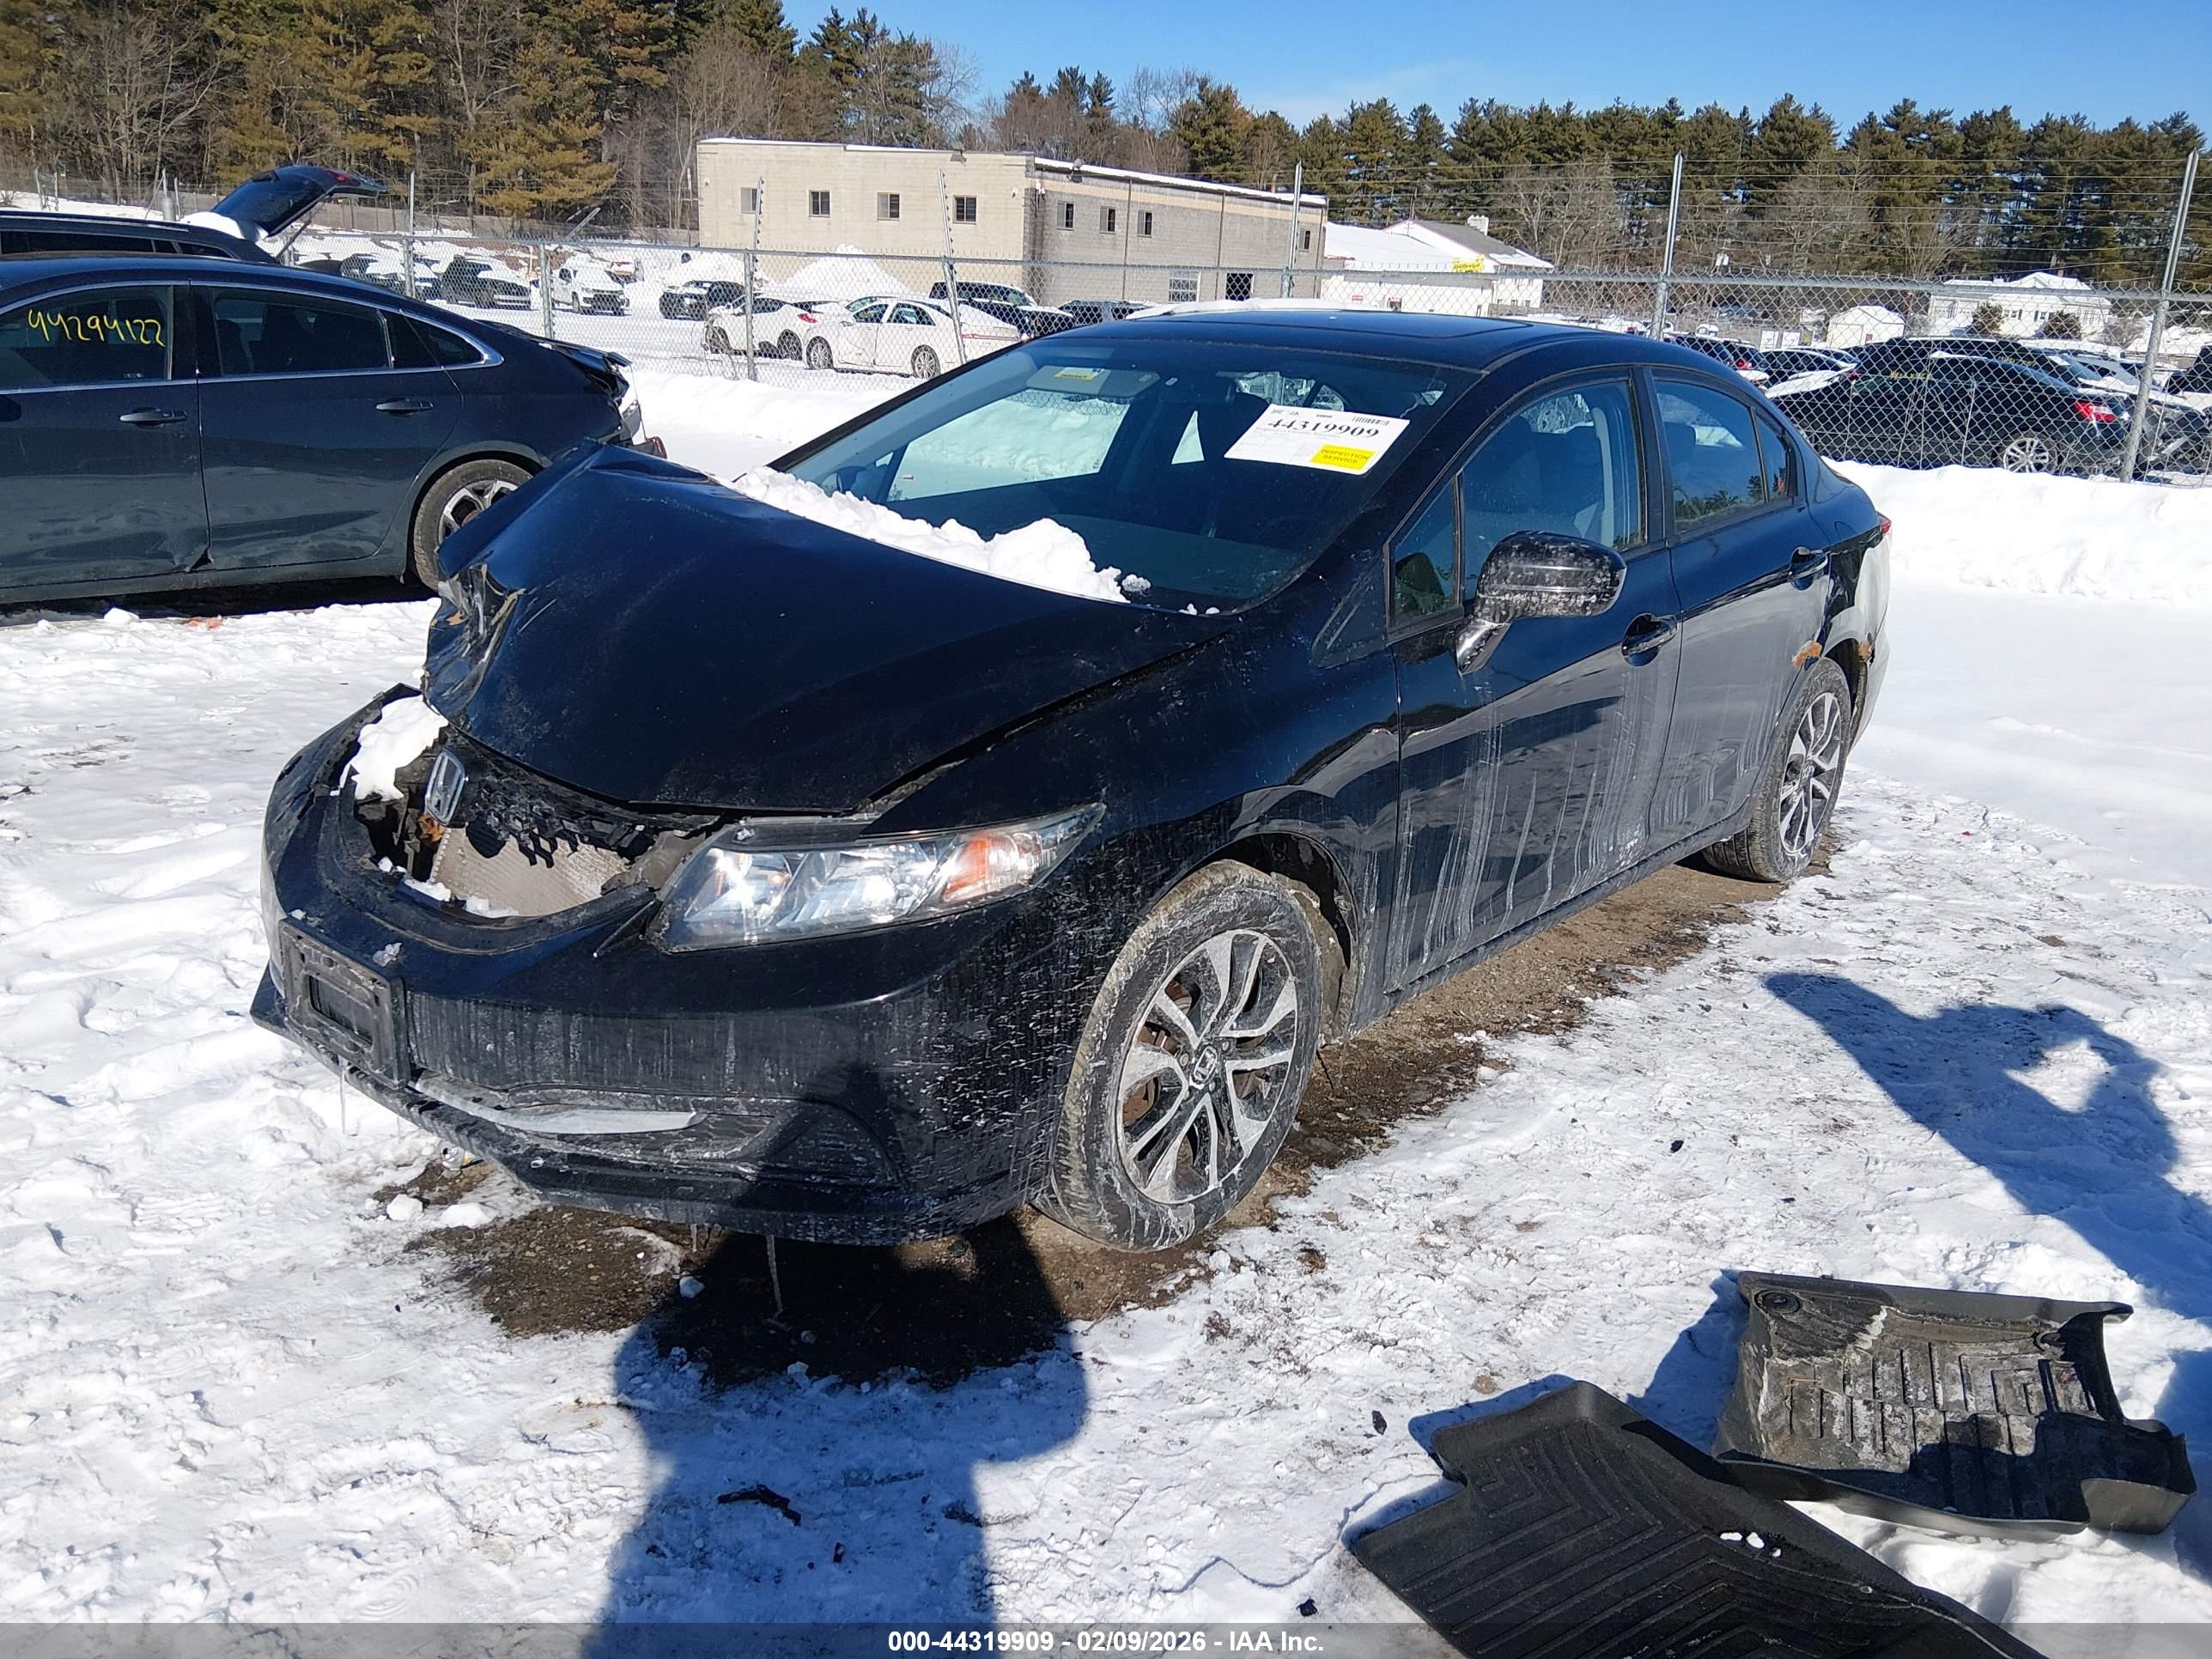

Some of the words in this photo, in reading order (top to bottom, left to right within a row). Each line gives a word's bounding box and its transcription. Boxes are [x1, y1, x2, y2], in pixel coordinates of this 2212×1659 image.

[28, 309, 166, 347] 44294122
[1267, 418, 1380, 439] 44319909
[1321, 448, 1370, 460] INSPECTION
[1322, 454, 1359, 464] SERVICE
